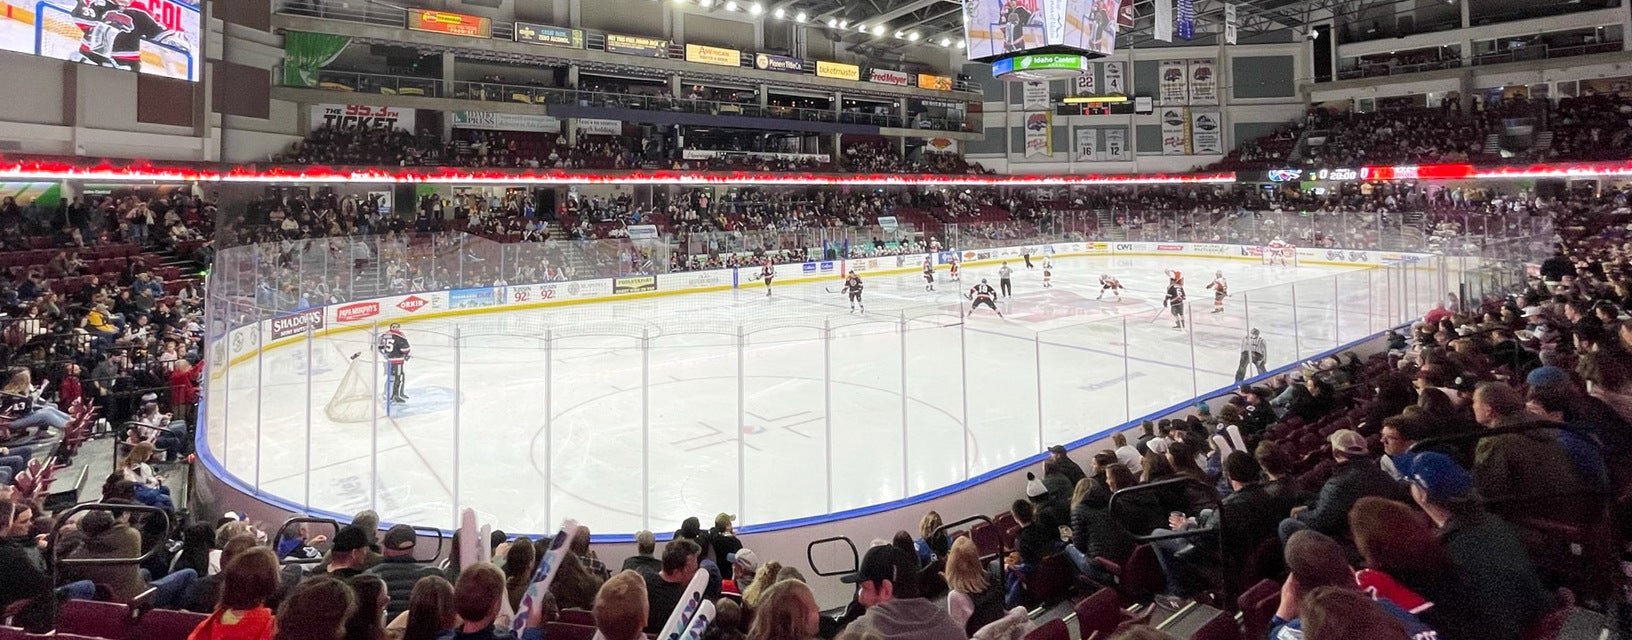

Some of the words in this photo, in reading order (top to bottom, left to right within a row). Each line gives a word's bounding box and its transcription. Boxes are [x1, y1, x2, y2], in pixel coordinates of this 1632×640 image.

[819, 65, 857, 77] ticketmaster
[1079, 77, 1093, 87] 22
[1111, 79, 1118, 88] 4
[323, 115, 398, 132] TICKET
[1083, 147, 1092, 156] 16
[1111, 147, 1120, 156] 12
[1319, 169, 1328, 179] 0
[1329, 171, 1357, 180] 20:00
[1360, 167, 1369, 179] 0
[1116, 243, 1132, 251] CWI
[400, 299, 424, 309] ORKIN
[339, 308, 351, 317] PAPA
